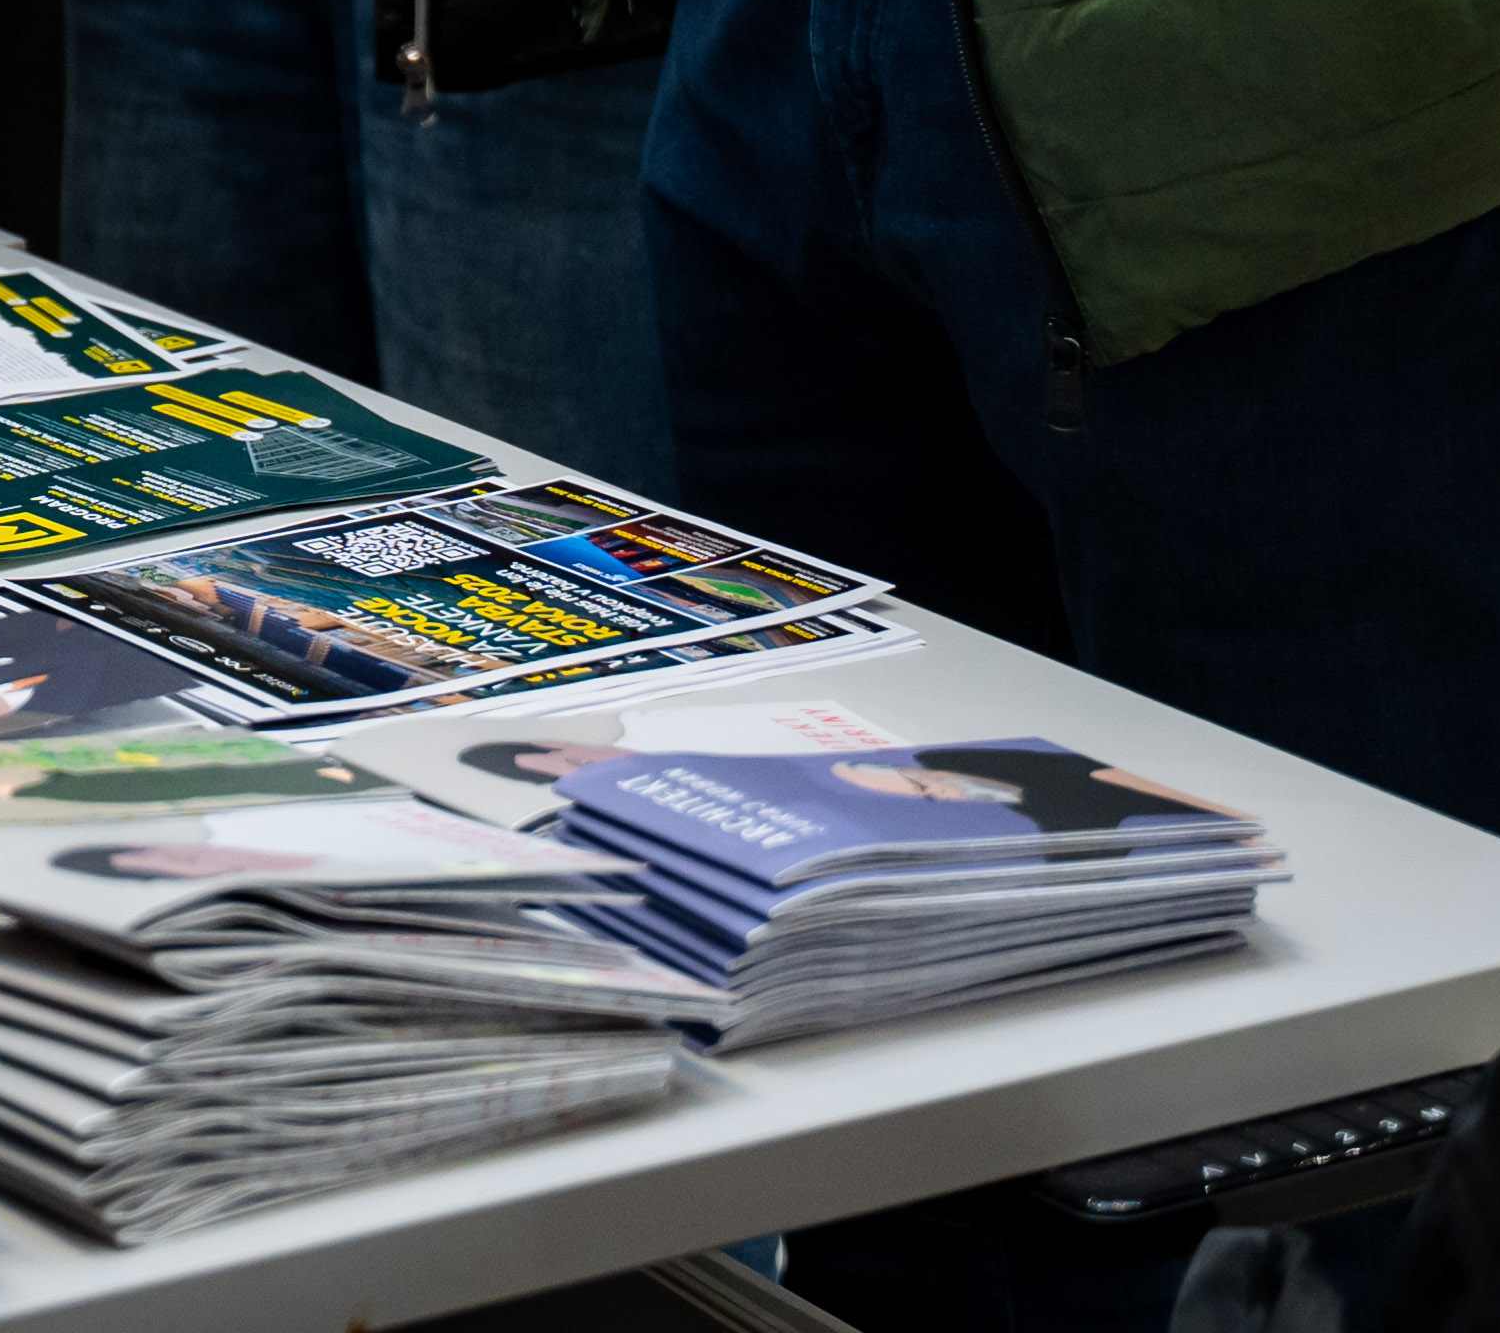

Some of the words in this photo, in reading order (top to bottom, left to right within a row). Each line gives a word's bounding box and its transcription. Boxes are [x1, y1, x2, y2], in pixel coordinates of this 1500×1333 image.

[26, 495, 130, 529] PROGRAM
[438, 572, 536, 604] 2025
[483, 569, 532, 583] len
[494, 560, 585, 590] bazéne.
[513, 580, 553, 591] je
[533, 588, 582, 602] nie
[566, 587, 599, 596] v
[348, 596, 480, 644] NOCKE
[390, 592, 535, 644] ANKETE
[444, 594, 592, 647] STAVBA
[510, 600, 627, 640] ROKA
[565, 599, 623, 618] hlas
[580, 593, 681, 627] kvapkou
[603, 614, 659, 632] Váš
[320, 605, 492, 668] HLASUJTE
[457, 639, 525, 661] ZA
[506, 639, 560, 654] V
[769, 716, 858, 751] ITEKT
[616, 773, 797, 849] ARCHITEKT
